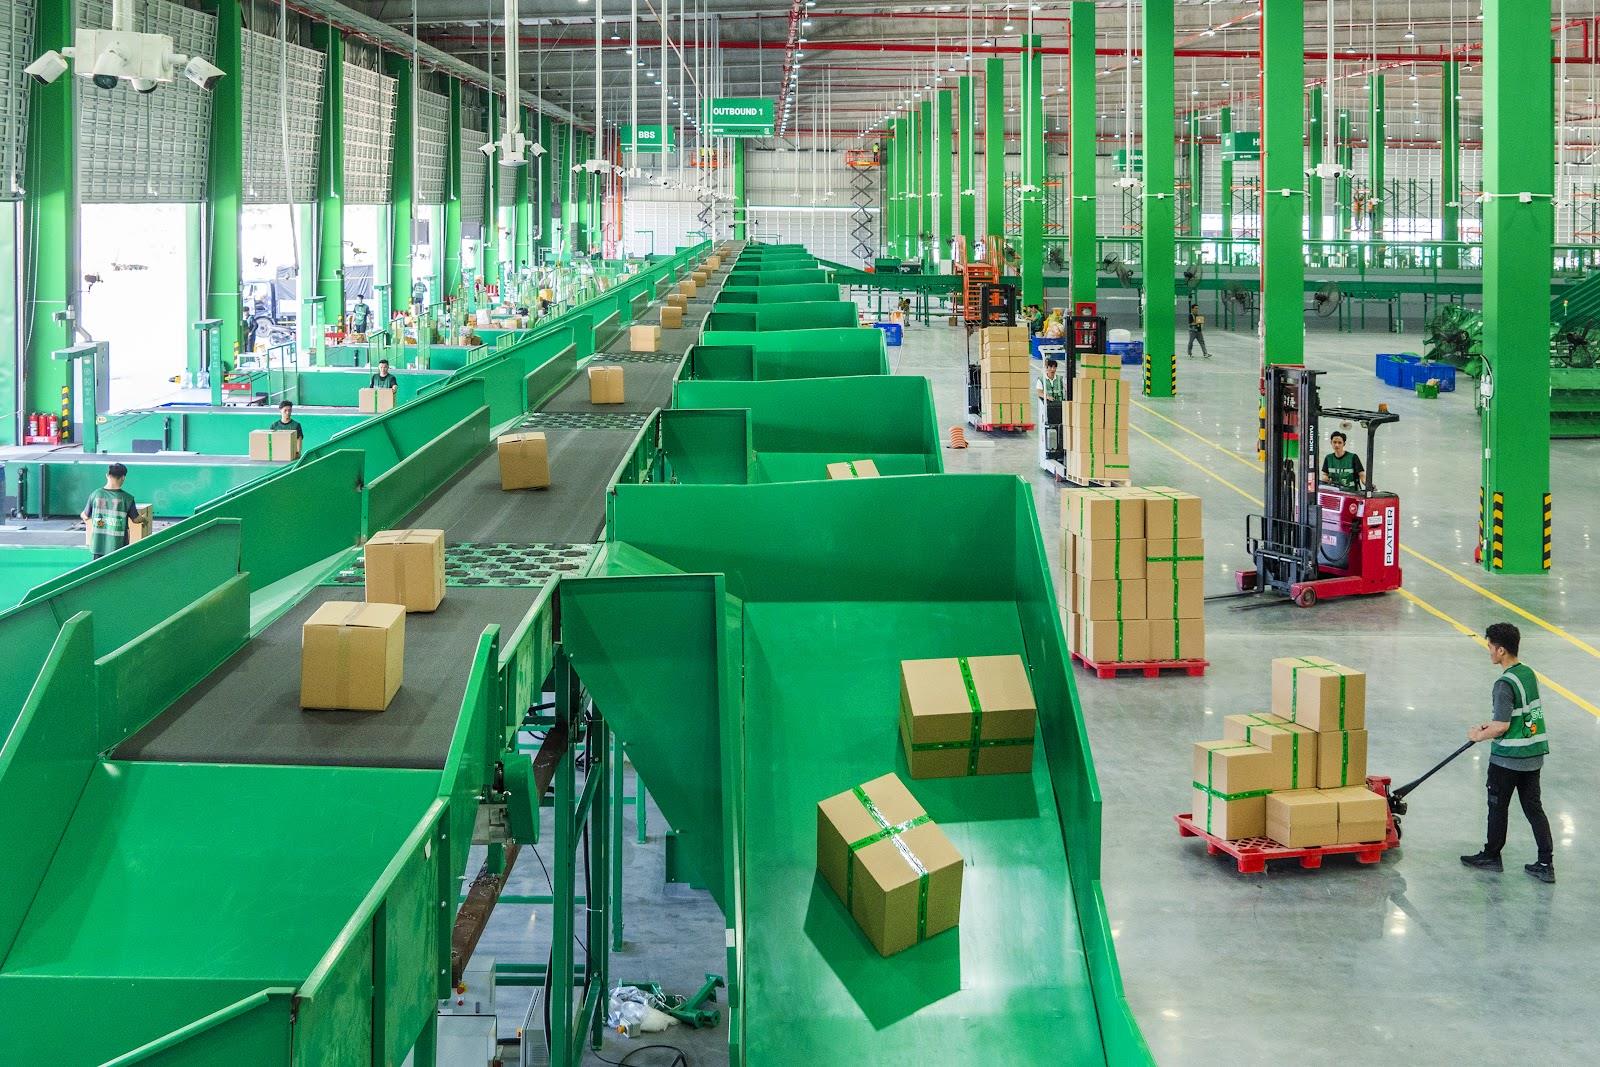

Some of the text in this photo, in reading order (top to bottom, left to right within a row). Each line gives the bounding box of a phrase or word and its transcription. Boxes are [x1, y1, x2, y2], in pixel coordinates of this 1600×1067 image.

[713, 107, 763, 116] OUTBOUND 1
[638, 131, 656, 139] BBS
